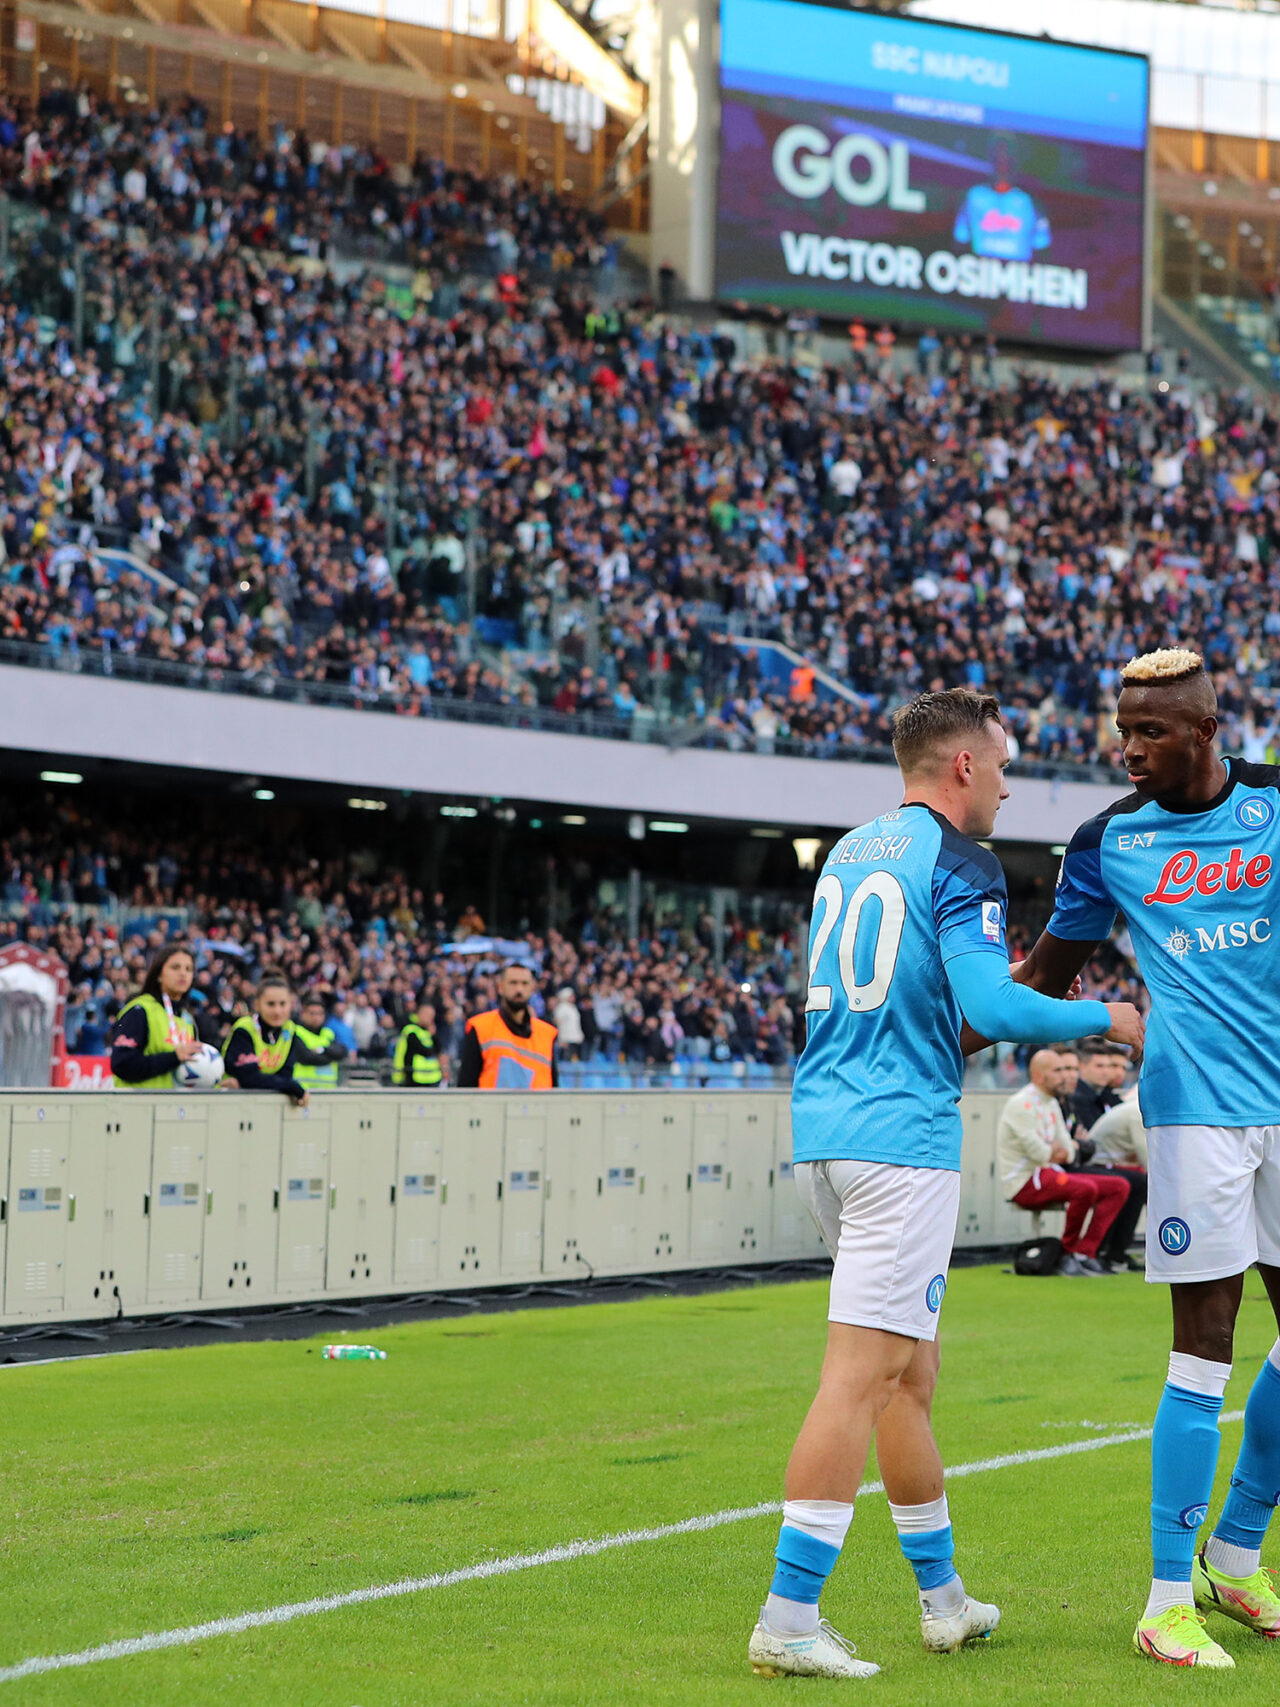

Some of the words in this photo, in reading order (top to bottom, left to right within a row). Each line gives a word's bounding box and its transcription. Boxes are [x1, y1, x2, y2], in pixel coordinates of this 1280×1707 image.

[872, 42, 919, 75] SSC
[922, 51, 1010, 88] NAPOLI
[773, 124, 926, 212] GOL
[781, 231, 922, 288] VICTOR
[925, 250, 1087, 310] OSIMHEN
[1245, 804, 1264, 822] N
[828, 831, 913, 866] ZIELIŃSKI
[1118, 832, 1157, 850] EA7
[1143, 848, 1272, 905] Lete
[805, 870, 906, 1013] 20
[1195, 917, 1272, 953] MSC
[1165, 1226, 1181, 1245] N
